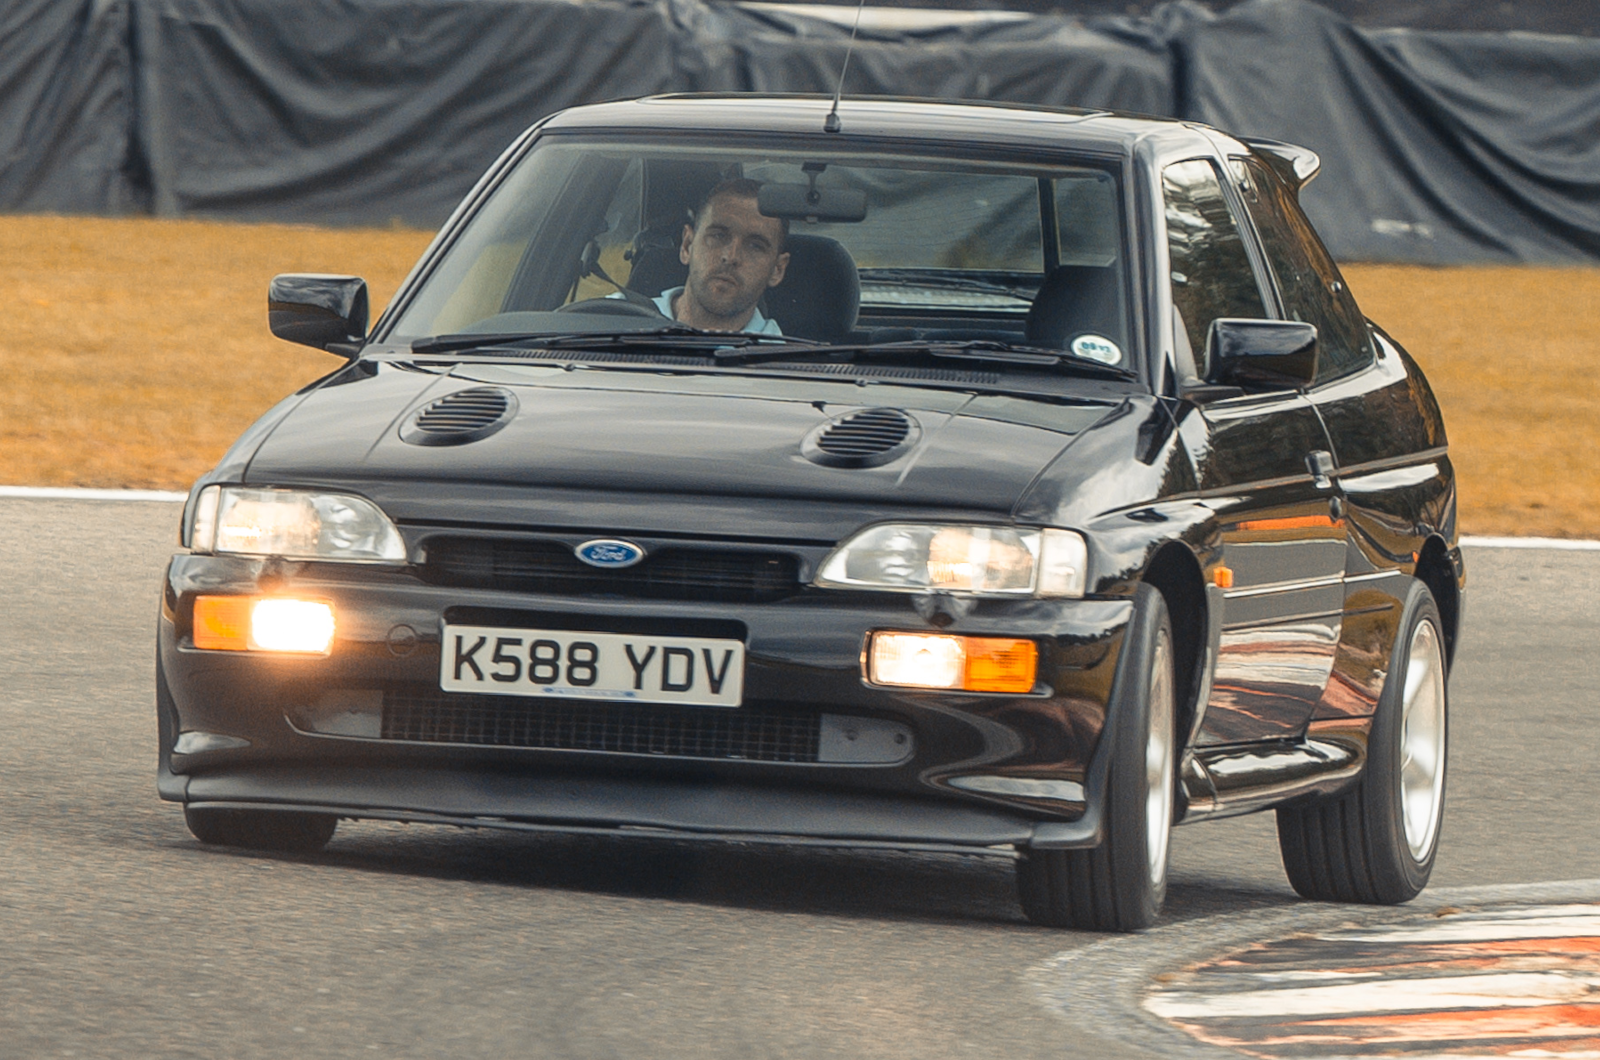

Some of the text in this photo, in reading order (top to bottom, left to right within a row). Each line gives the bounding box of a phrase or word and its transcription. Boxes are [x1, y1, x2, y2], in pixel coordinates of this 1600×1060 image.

[590, 545, 628, 561] Ford
[454, 634, 734, 695] K588 YDV
